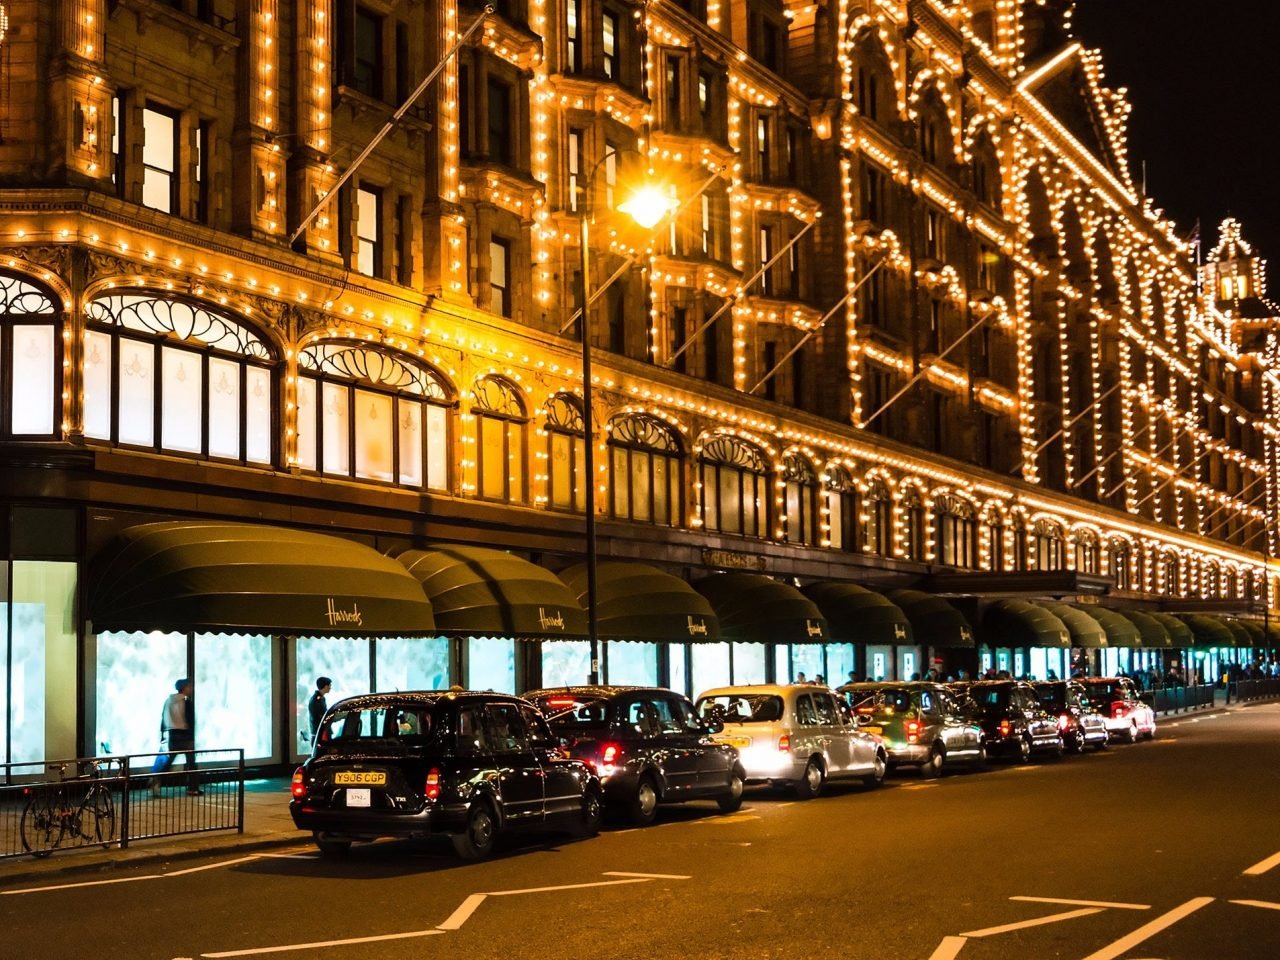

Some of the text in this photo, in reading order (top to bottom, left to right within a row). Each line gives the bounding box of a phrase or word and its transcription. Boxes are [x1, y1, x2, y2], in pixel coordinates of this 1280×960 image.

[324, 597, 362, 626] Harrods
[536, 607, 564, 630] Harrods
[337, 773, 385, 783] Y906 CGP
